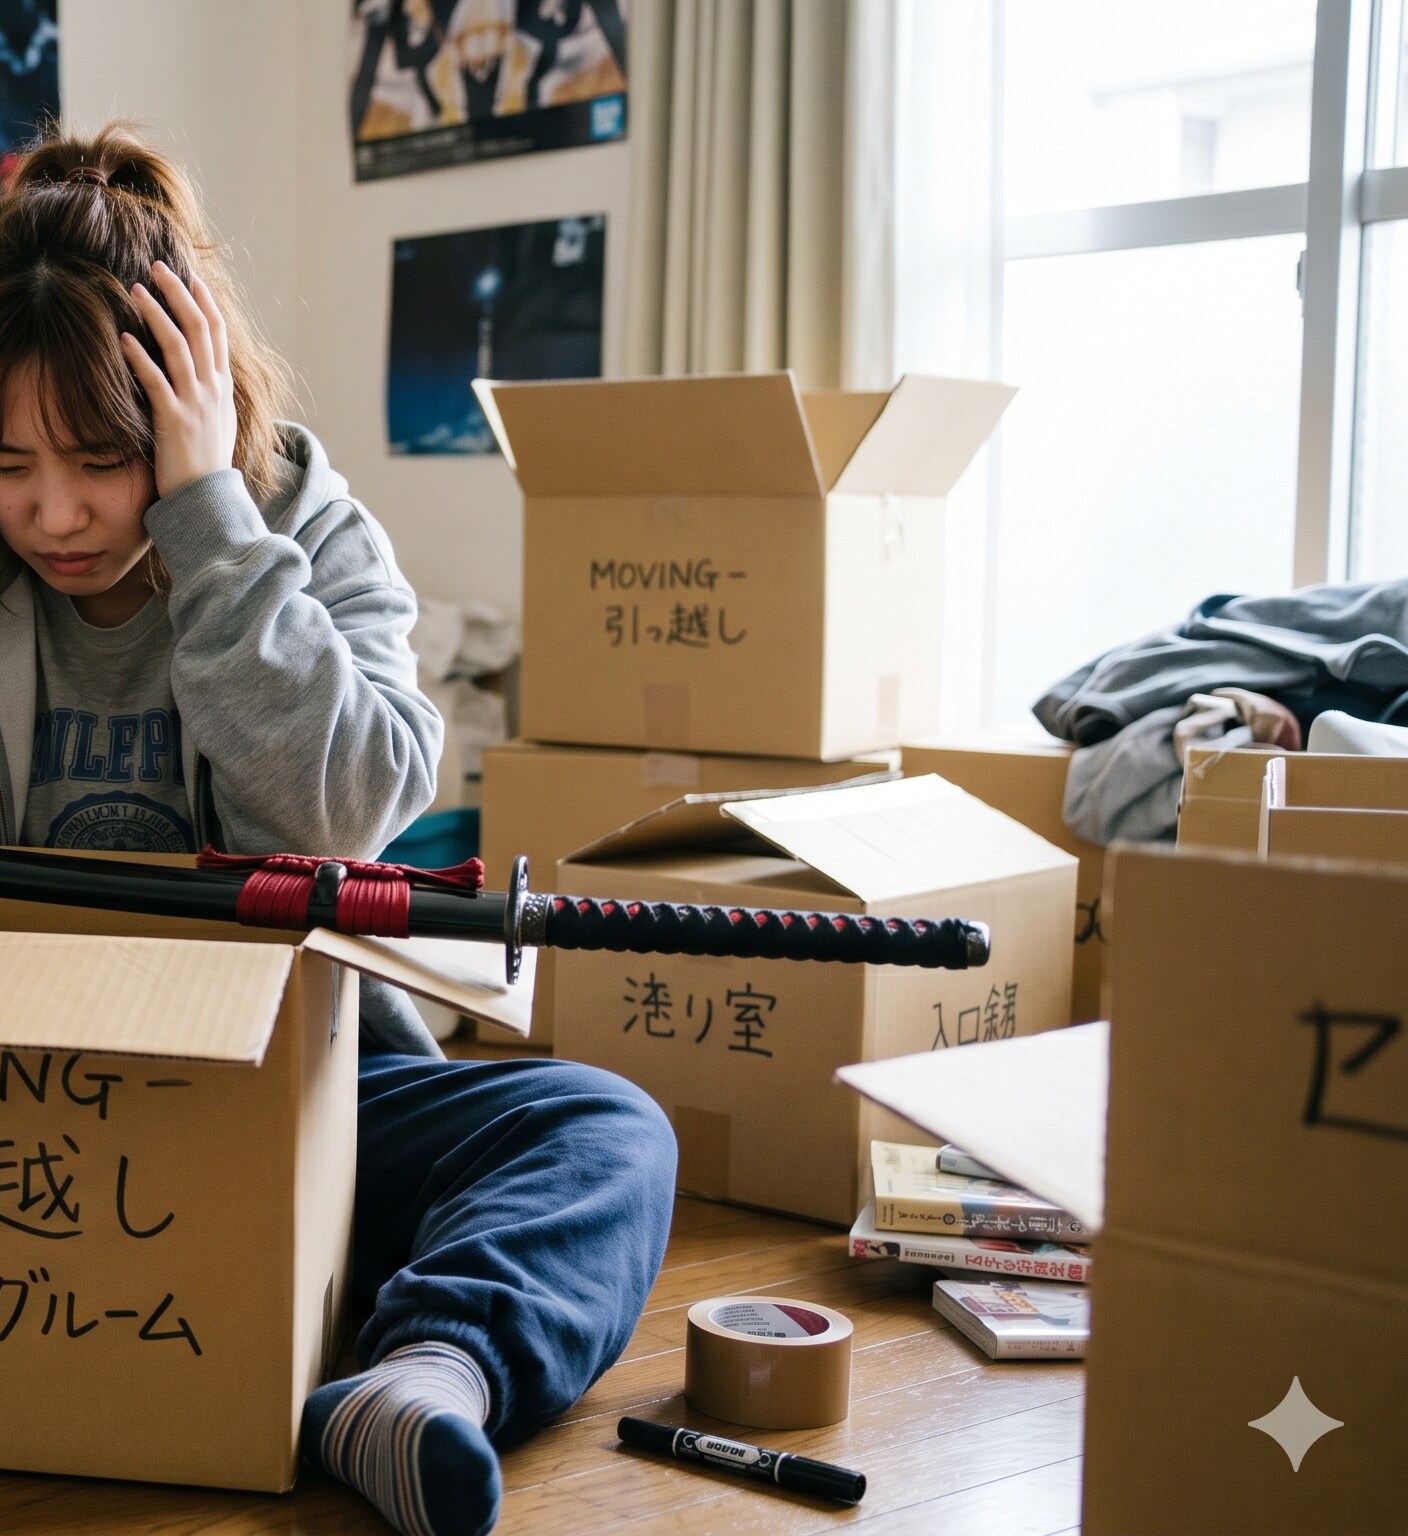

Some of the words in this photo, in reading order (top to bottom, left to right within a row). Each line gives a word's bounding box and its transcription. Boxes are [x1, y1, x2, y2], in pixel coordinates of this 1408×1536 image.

[589, 558, 719, 591] MOVING
[605, 602, 746, 648] 引っ越し
